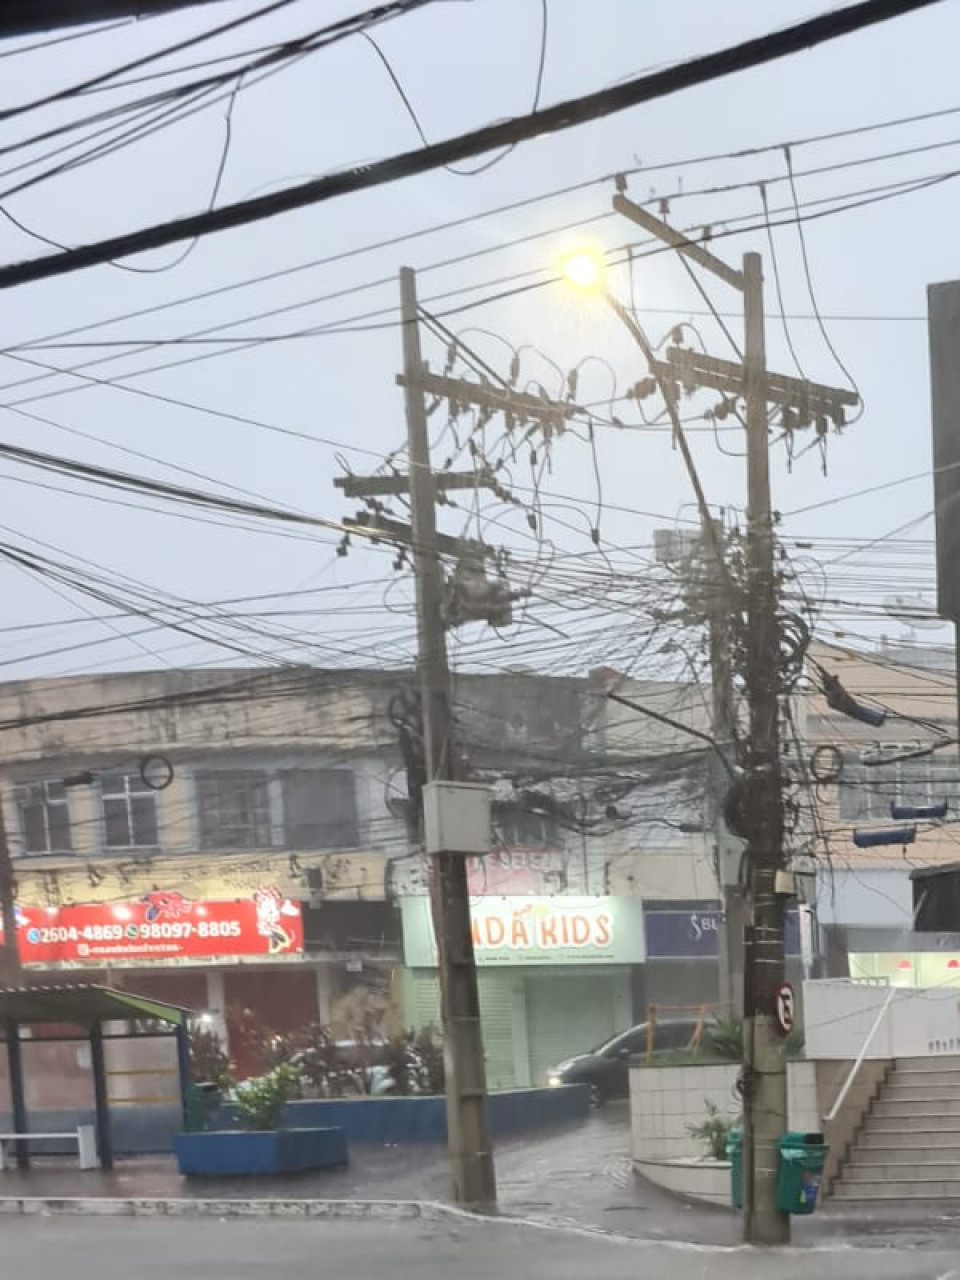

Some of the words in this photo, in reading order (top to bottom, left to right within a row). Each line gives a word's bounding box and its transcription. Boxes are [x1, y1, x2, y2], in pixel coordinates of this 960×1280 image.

[41, 926, 122, 943] 2604-4869
[140, 921, 240, 939] 98097-8805
[541, 914, 610, 944] KIDS
